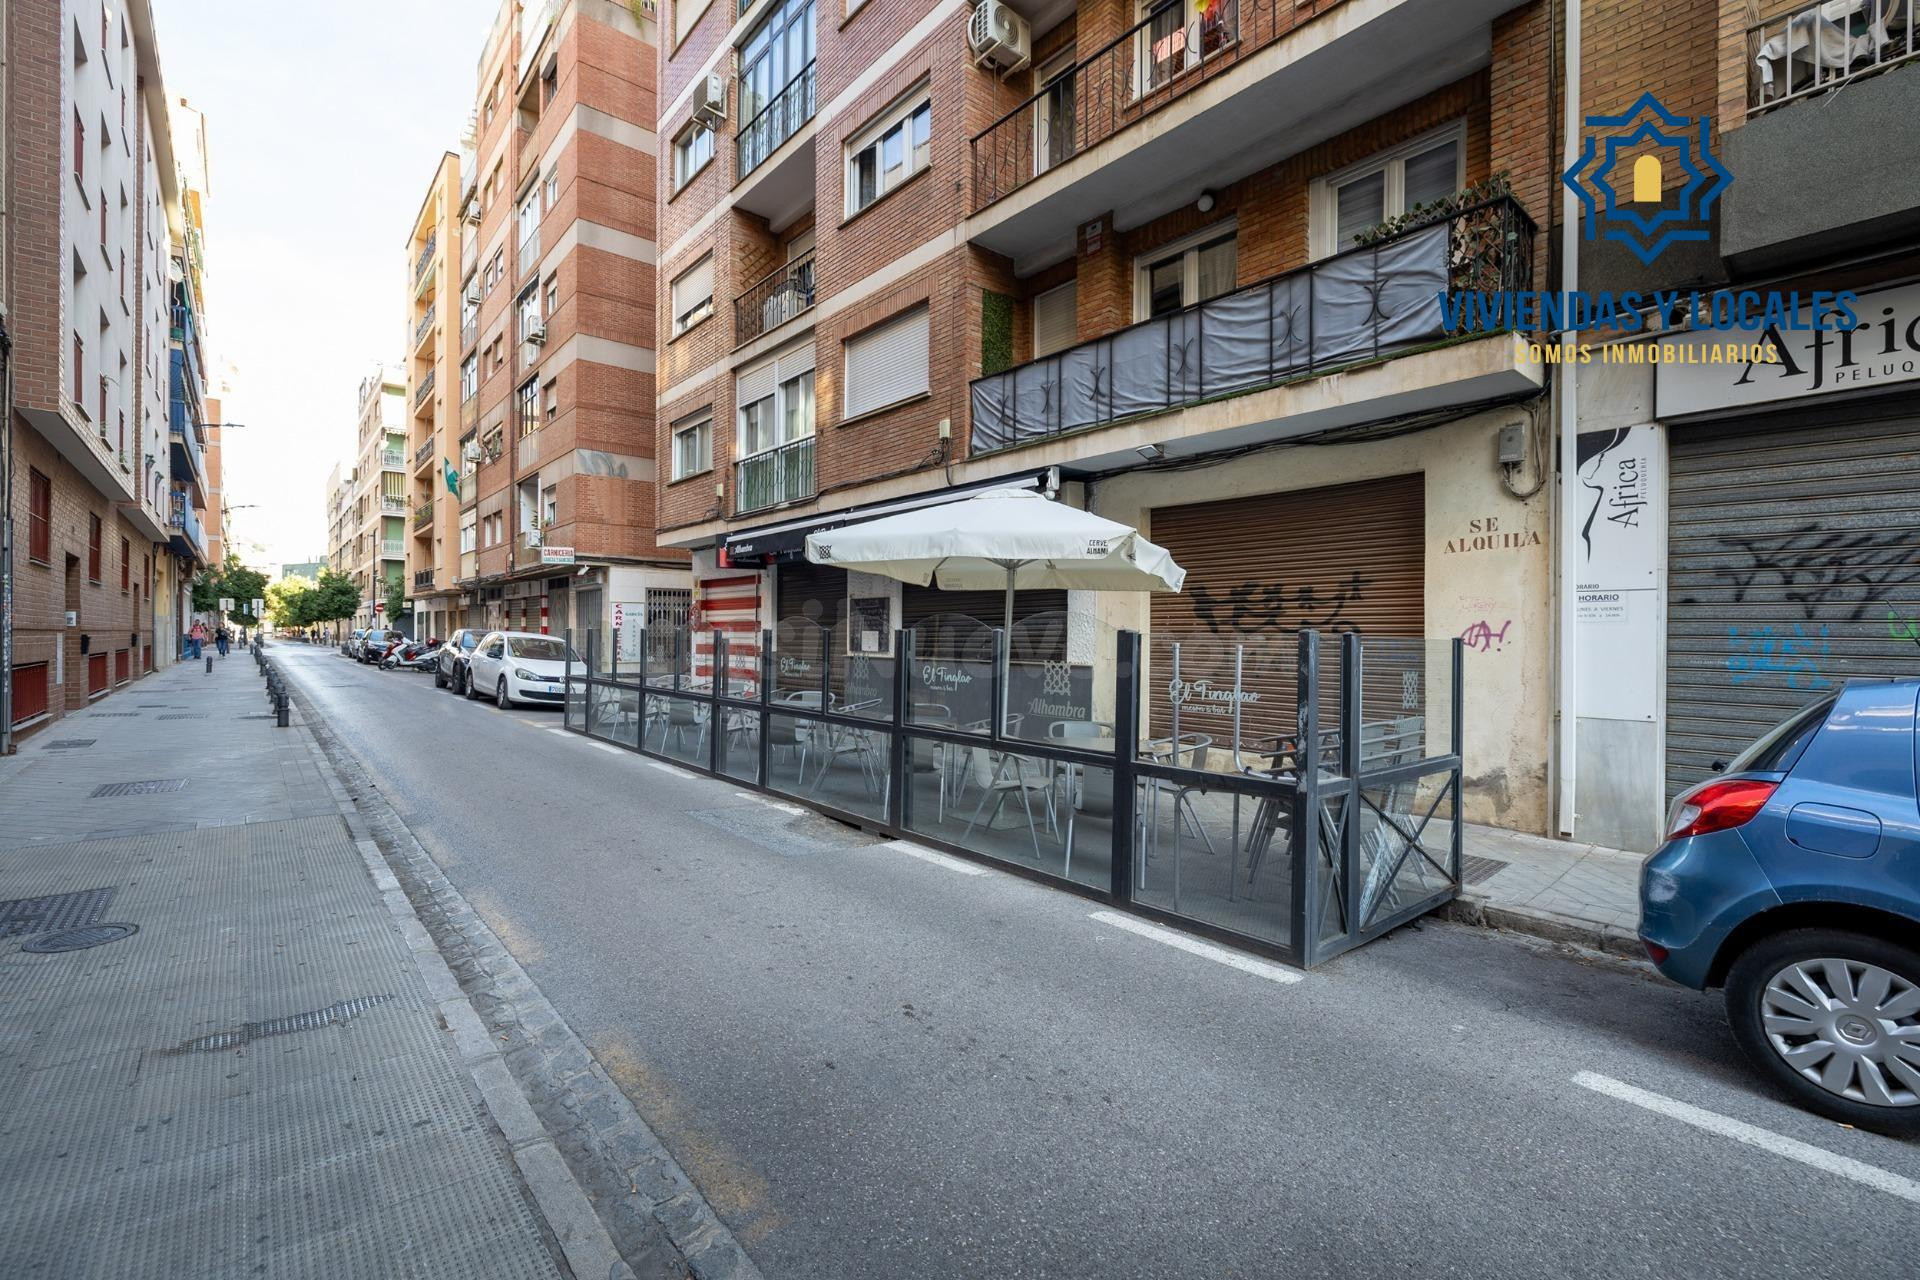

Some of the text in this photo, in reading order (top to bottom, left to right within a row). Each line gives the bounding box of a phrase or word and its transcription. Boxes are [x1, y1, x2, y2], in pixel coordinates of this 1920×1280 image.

[1835, 360, 1914, 384] PELUQ
[1607, 457, 1648, 529] Africa
[1469, 517, 1499, 534] SE
[1088, 539, 1108, 547] CERVE
[1444, 530, 1541, 554] ALQUILA
[1578, 593, 1620, 601] HORARIO
[923, 665, 936, 685] El
[1168, 679, 1192, 705] El
[1028, 697, 1087, 720] Alhambra
